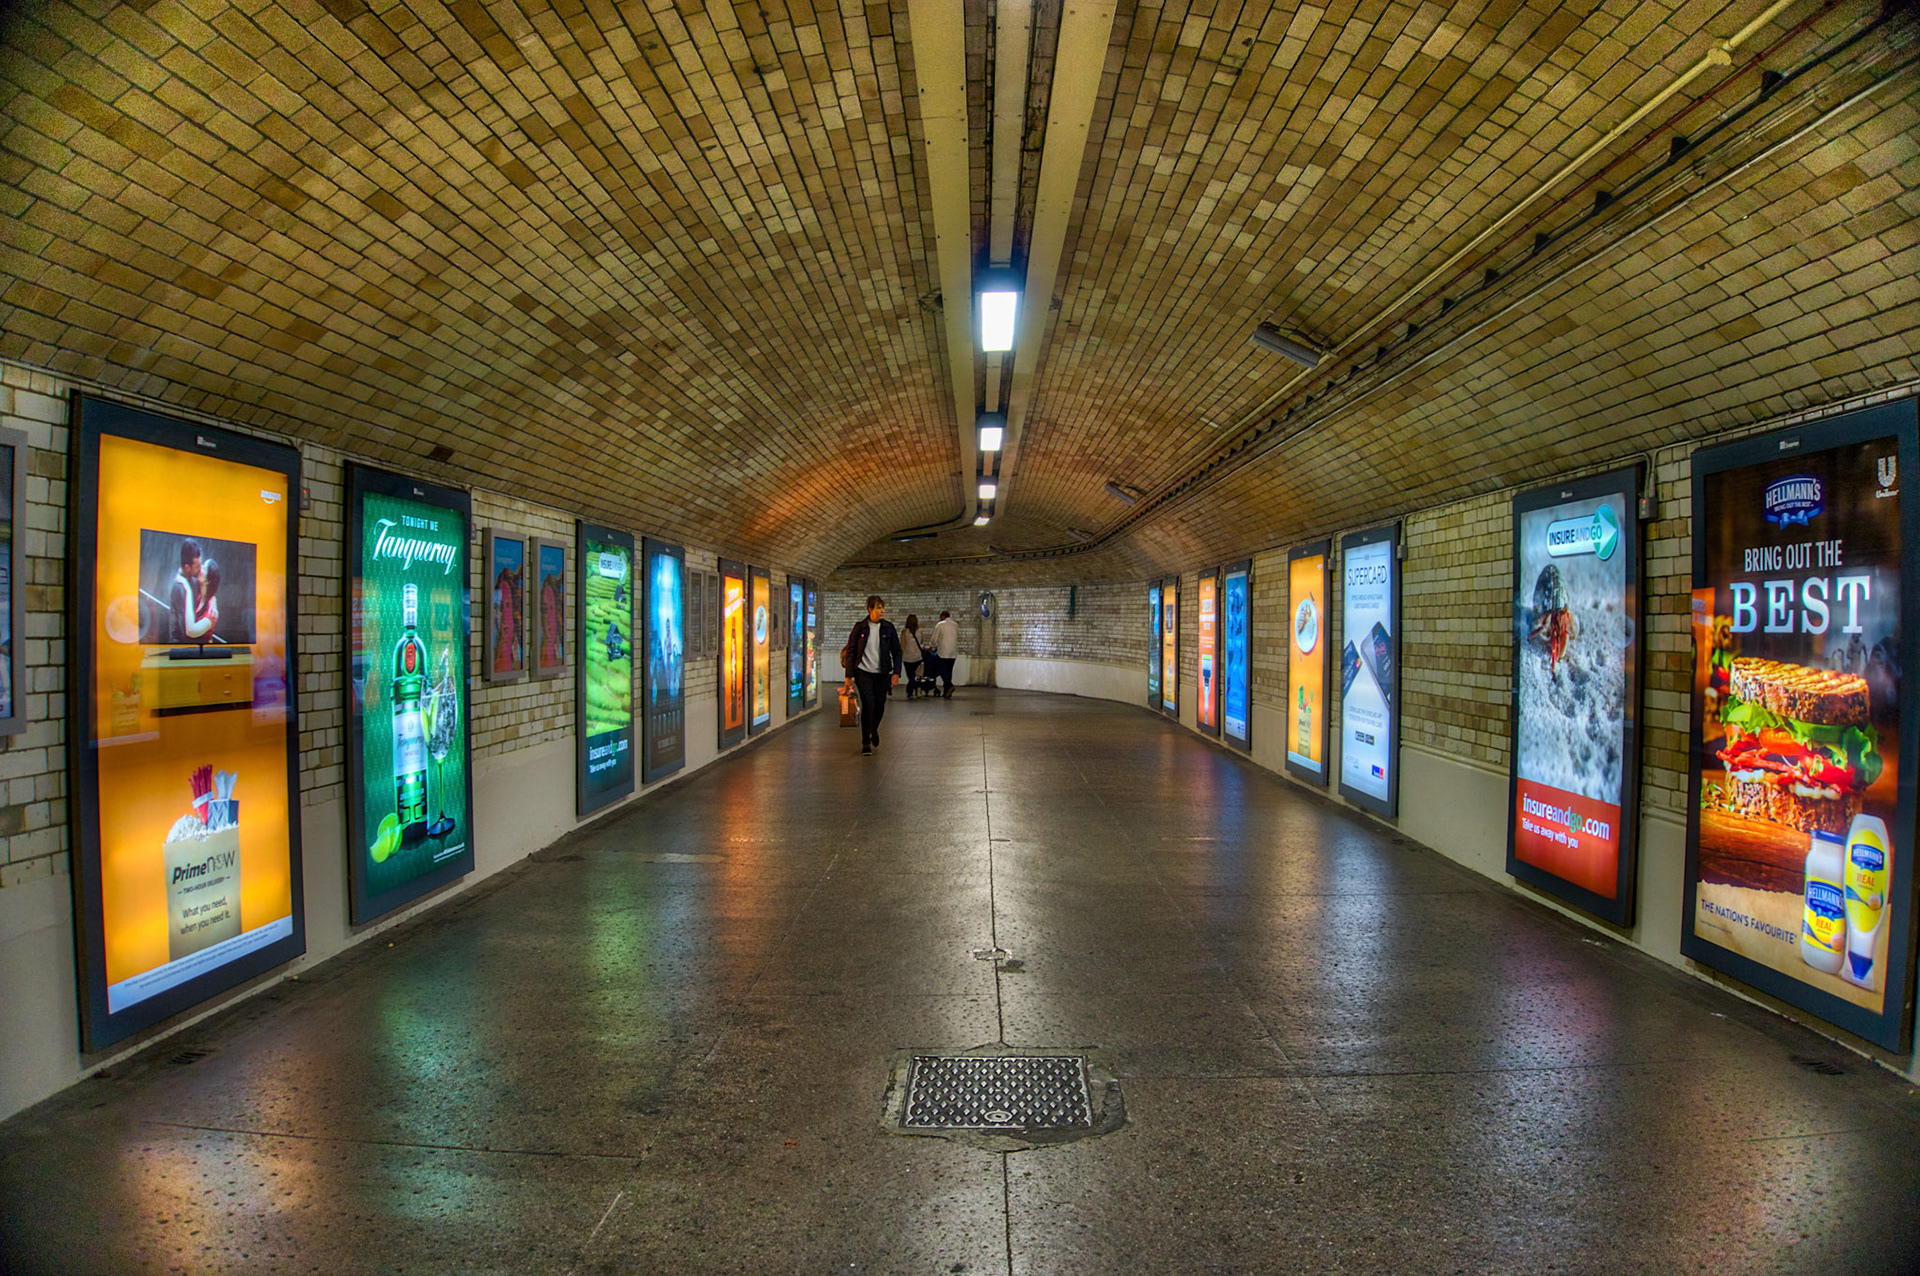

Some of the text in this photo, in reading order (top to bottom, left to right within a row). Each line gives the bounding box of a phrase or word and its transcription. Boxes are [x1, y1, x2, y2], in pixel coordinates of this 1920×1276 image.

[1766, 478, 1821, 509] HELLMANN'S
[402, 515, 428, 530] TONIGHT
[1548, 525, 1603, 546] INSUREANDGO
[372, 518, 457, 575] Tanqueray
[1744, 539, 1843, 573] BRING OUT THE
[1348, 565, 1388, 586] SUPERCARD
[1729, 575, 1871, 635] BEST
[1523, 792, 1611, 841] insureandgo.com
[1522, 817, 1579, 848] Take us away with you
[1856, 873, 1875, 888] REAL
[180, 923, 198, 935] when
[197, 919, 210, 932] you
[210, 911, 224, 924] need
[182, 906, 199, 919] What
[200, 904, 211, 916] you
[1701, 898, 1714, 914] THE
[1715, 905, 1750, 927] NATION'S
[1815, 918, 1833, 932] REAL
